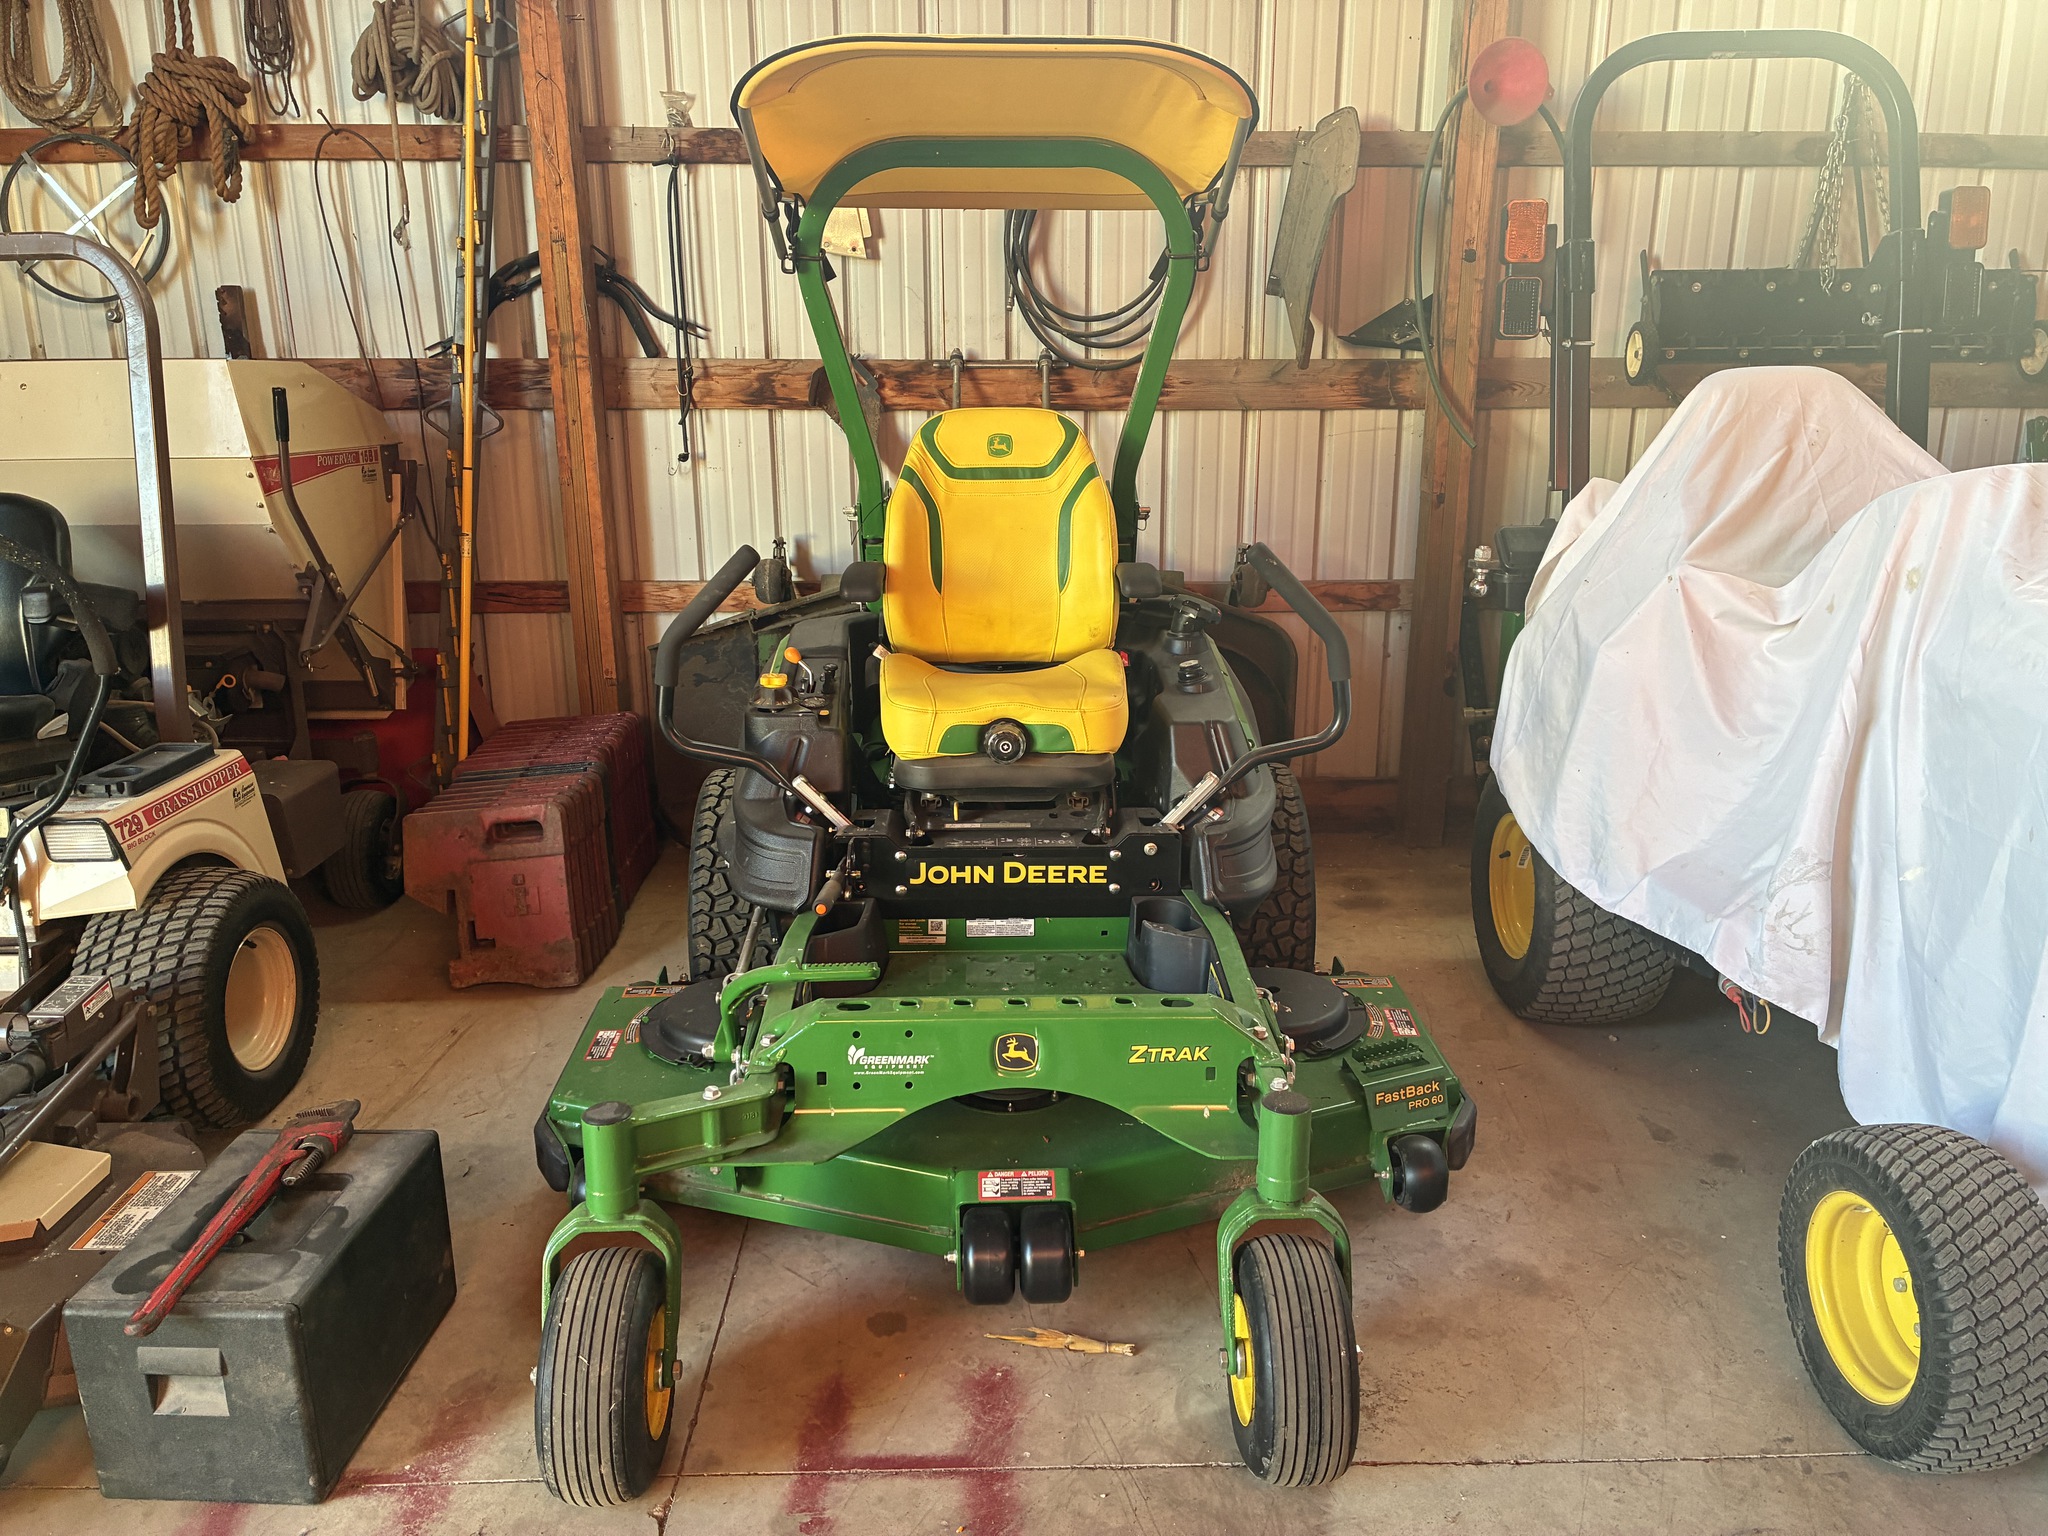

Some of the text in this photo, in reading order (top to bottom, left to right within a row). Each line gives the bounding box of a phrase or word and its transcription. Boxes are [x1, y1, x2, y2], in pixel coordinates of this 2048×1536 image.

[317, 453, 356, 466] POWERVAC
[152, 762, 242, 820] GRASSHOPPER
[115, 814, 144, 841] 729
[127, 831, 156, 850] BIG BLOCK
[910, 861, 1108, 885] JOHN DEERE
[1128, 1044, 1211, 1063] ZTRAK
[1376, 1080, 1440, 1105] FastBack
[1408, 1094, 1444, 1110] PRO 60
